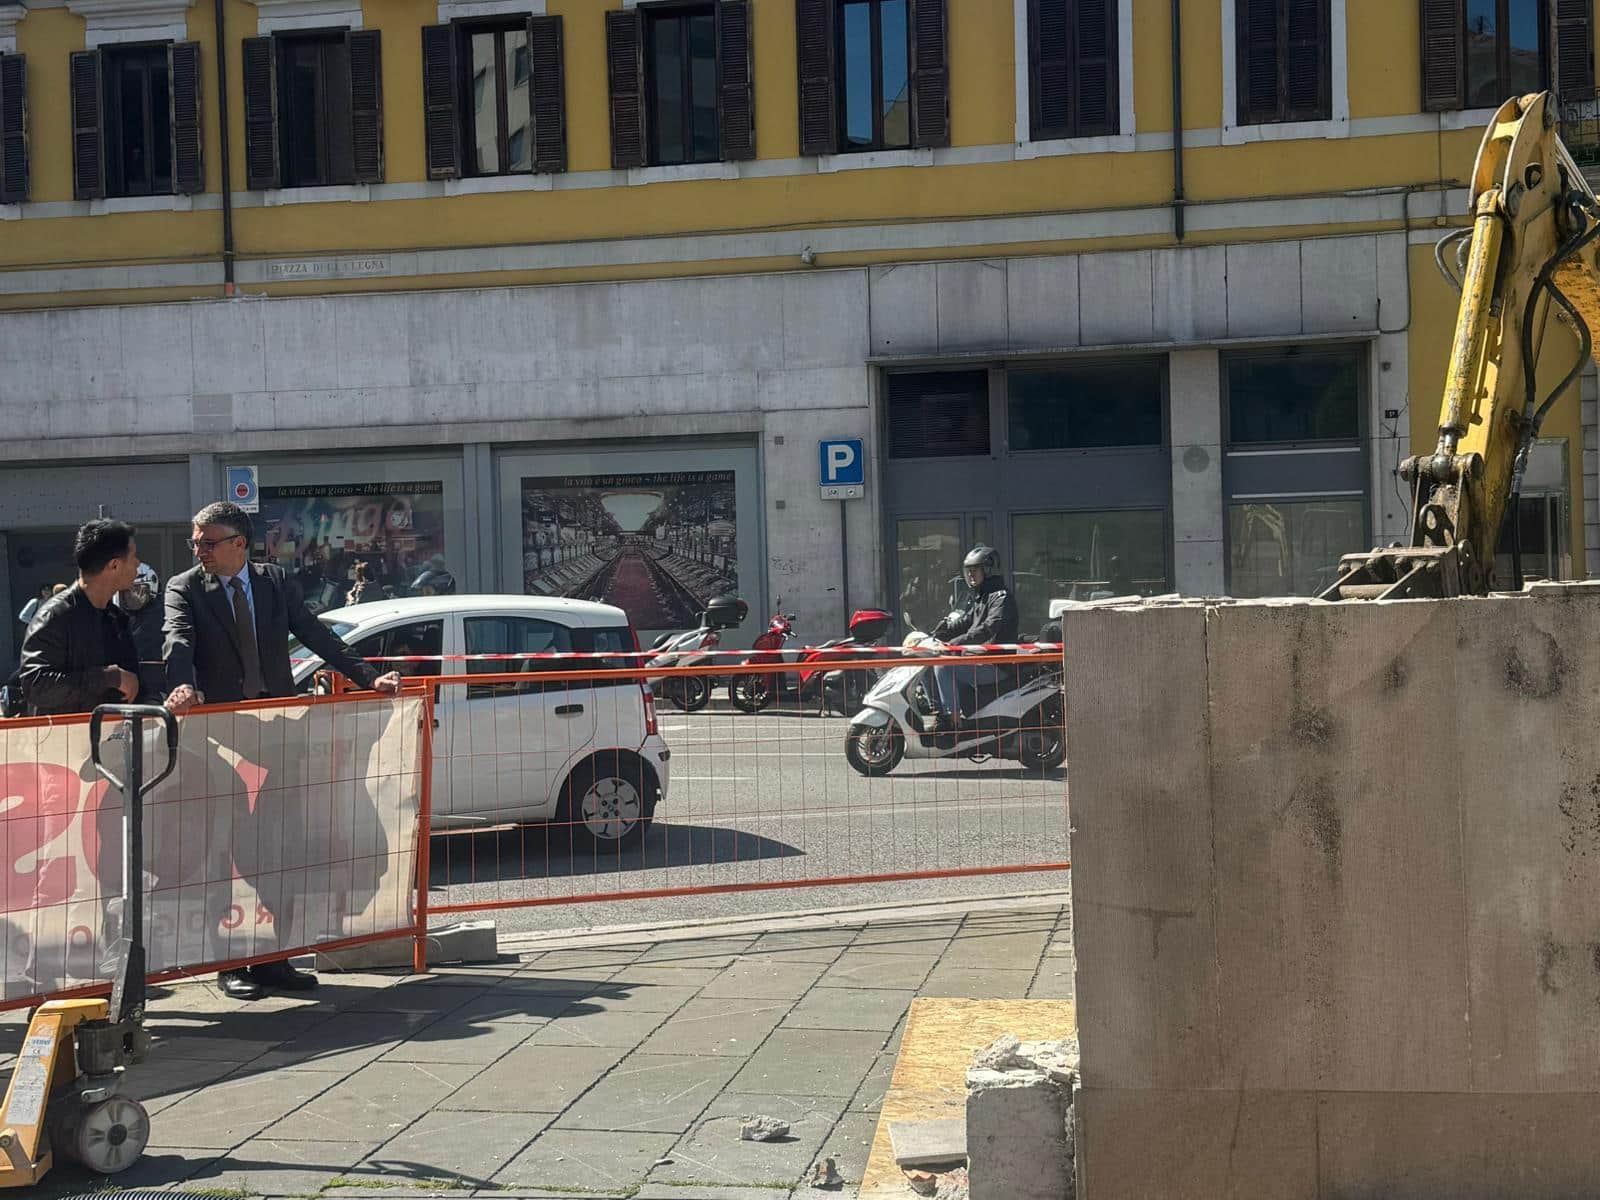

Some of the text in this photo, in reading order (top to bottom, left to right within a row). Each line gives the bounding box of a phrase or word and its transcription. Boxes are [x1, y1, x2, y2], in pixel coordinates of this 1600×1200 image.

[271, 263, 307, 274] PIAZZA
[827, 444, 855, 480] P
[653, 473, 668, 484] the
[363, 483, 379, 496] the
